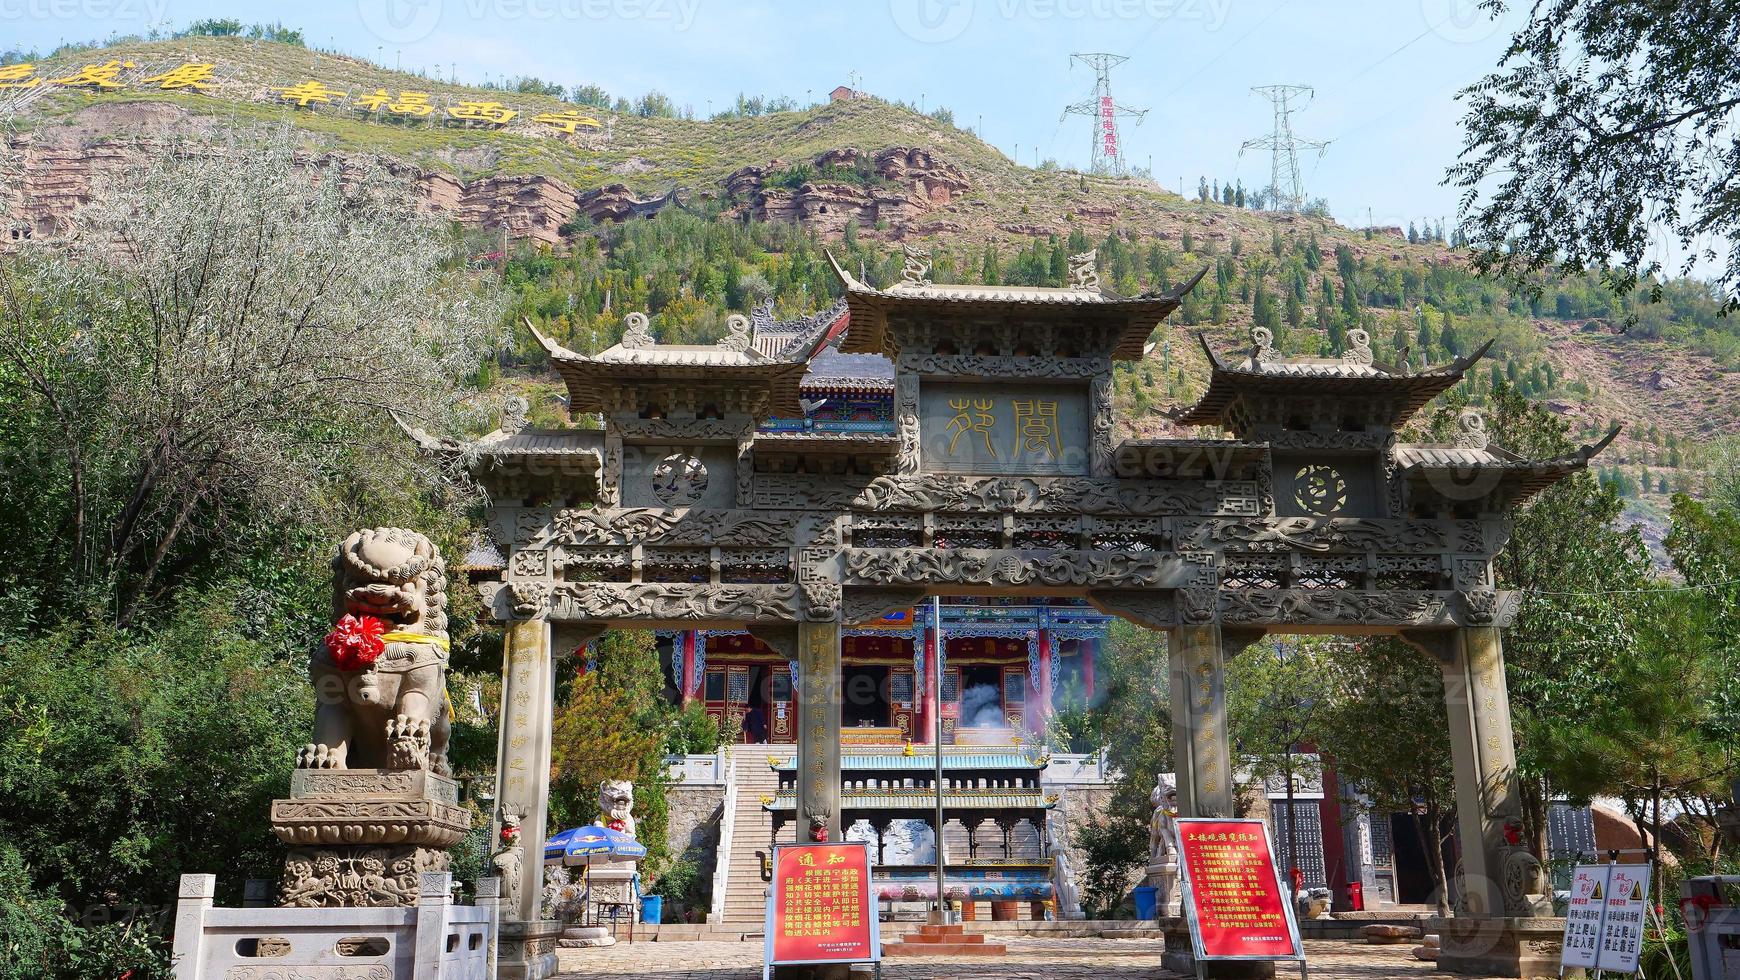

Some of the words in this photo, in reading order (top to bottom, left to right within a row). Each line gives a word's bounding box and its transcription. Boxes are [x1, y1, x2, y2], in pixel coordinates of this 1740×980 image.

[271, 80, 602, 134] 幸福西宁
[1100, 96, 1118, 157] 高压电危险
[799, 852, 845, 867] 通知
[1568, 923, 1597, 936] 禁止爬山
[1606, 925, 1637, 938] 禁止爬山
[1604, 939, 1634, 953] 禁止靠近
